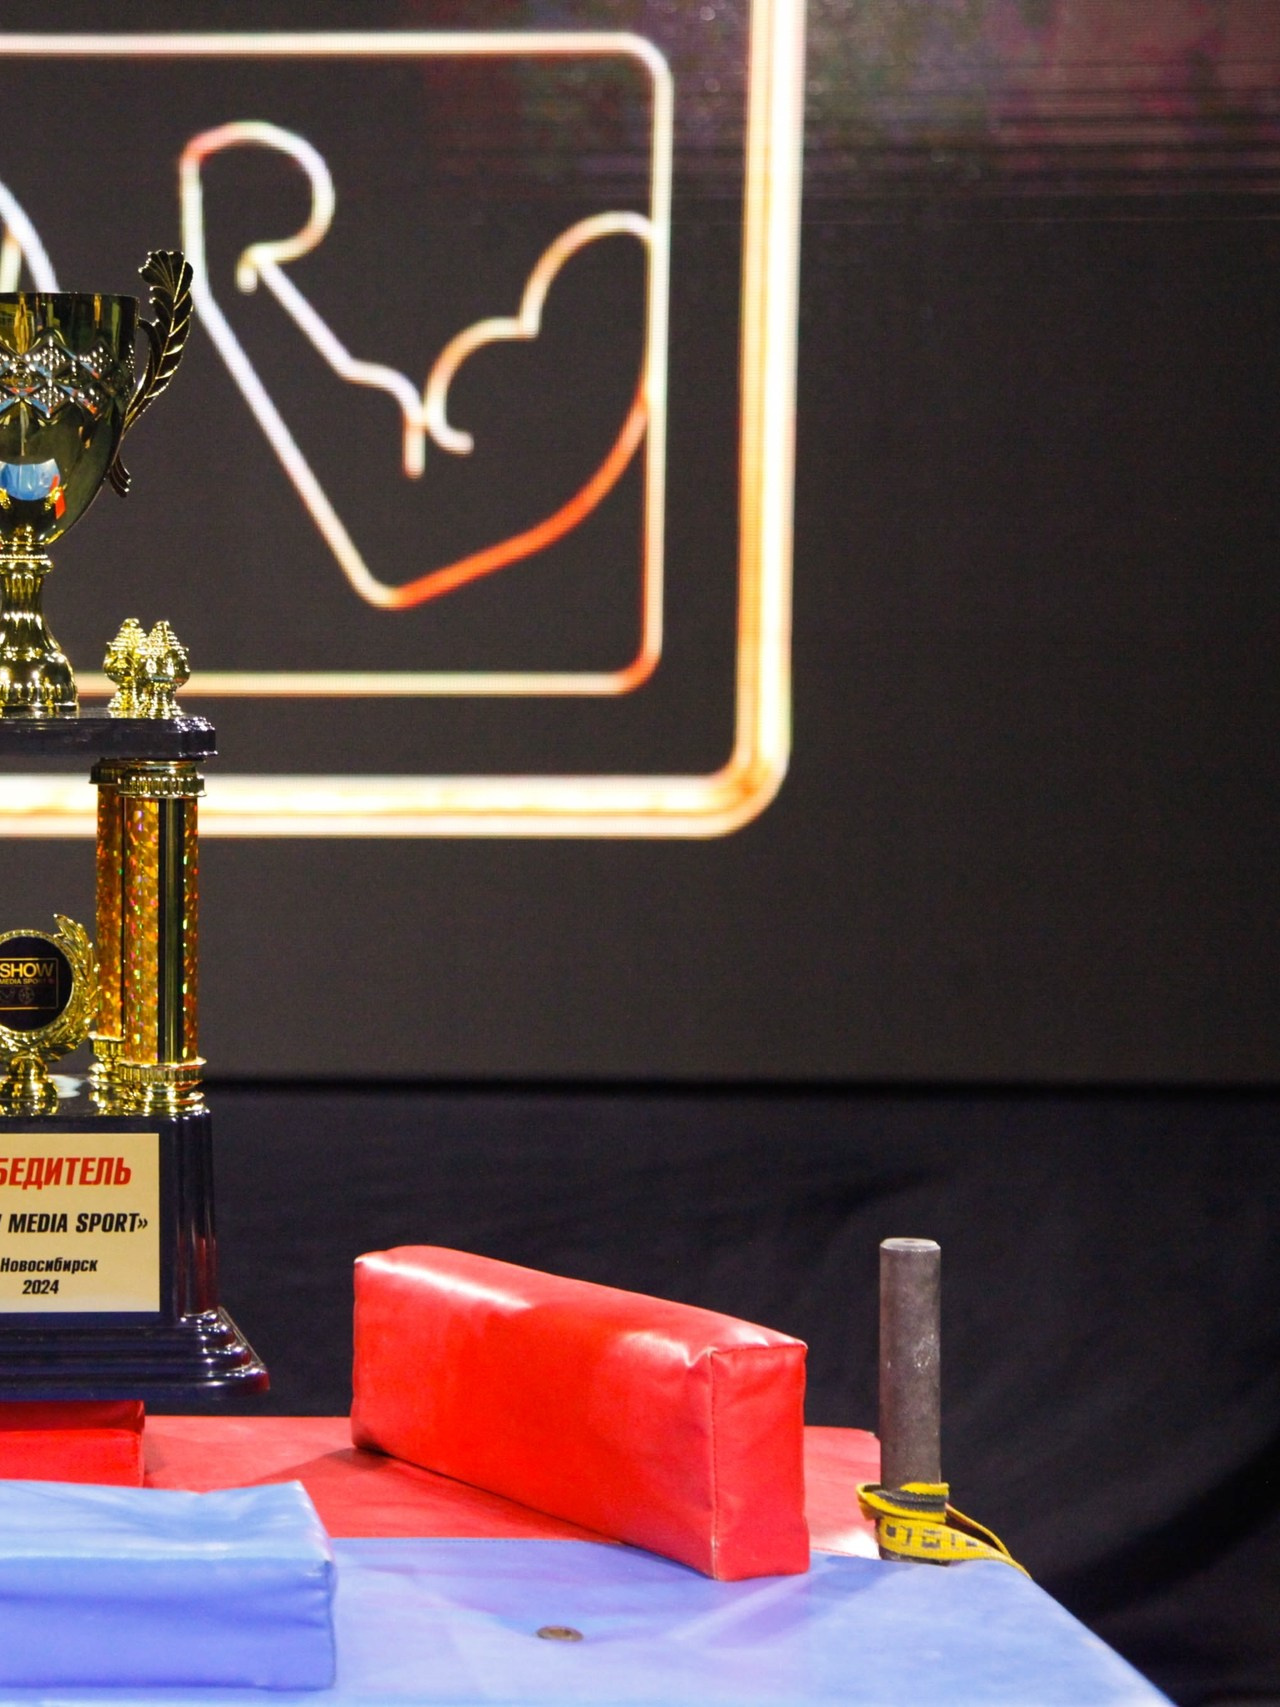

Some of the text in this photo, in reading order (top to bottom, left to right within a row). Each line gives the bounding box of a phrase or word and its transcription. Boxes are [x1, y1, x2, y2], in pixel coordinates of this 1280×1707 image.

[0, 963, 54, 978] SHOW
[8, 1213, 68, 1233] MEDIA
[76, 1213, 148, 1233] SPORT»
[0, 1257, 98, 1275] Новосибирск
[22, 1279, 60, 1295] 2024
